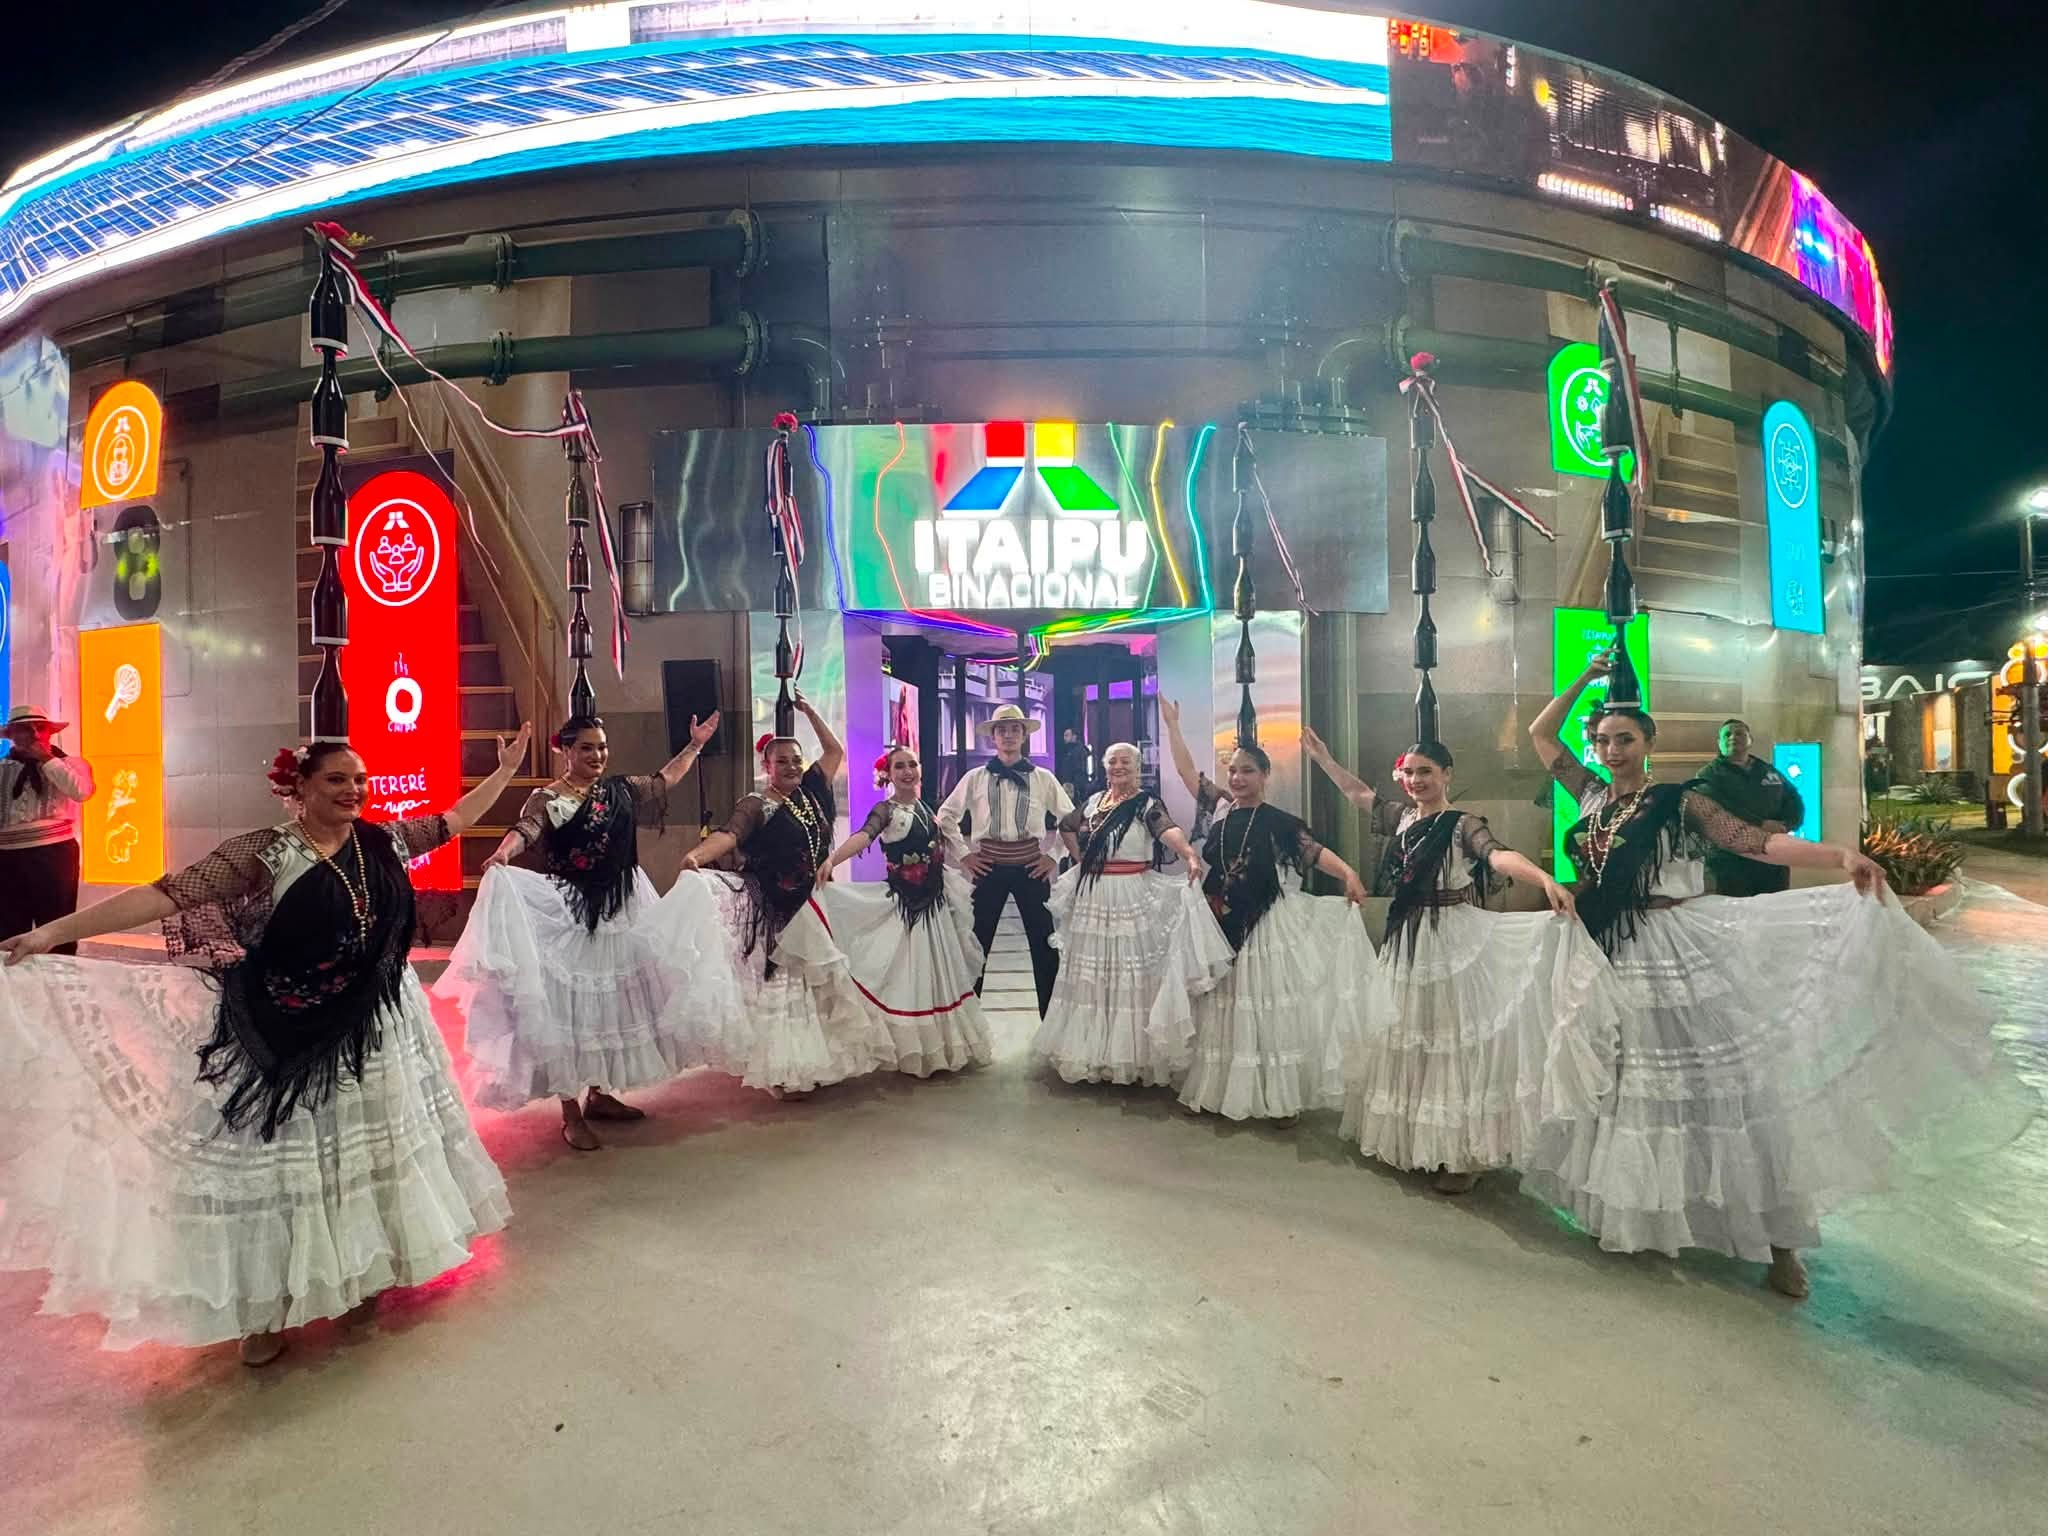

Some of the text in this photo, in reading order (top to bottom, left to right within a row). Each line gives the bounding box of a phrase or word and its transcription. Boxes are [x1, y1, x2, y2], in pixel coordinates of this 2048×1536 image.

[913, 519, 1148, 574] ITAIPU
[929, 571, 1139, 609] BINACIONAL
[368, 766, 427, 796] TERERÉ
